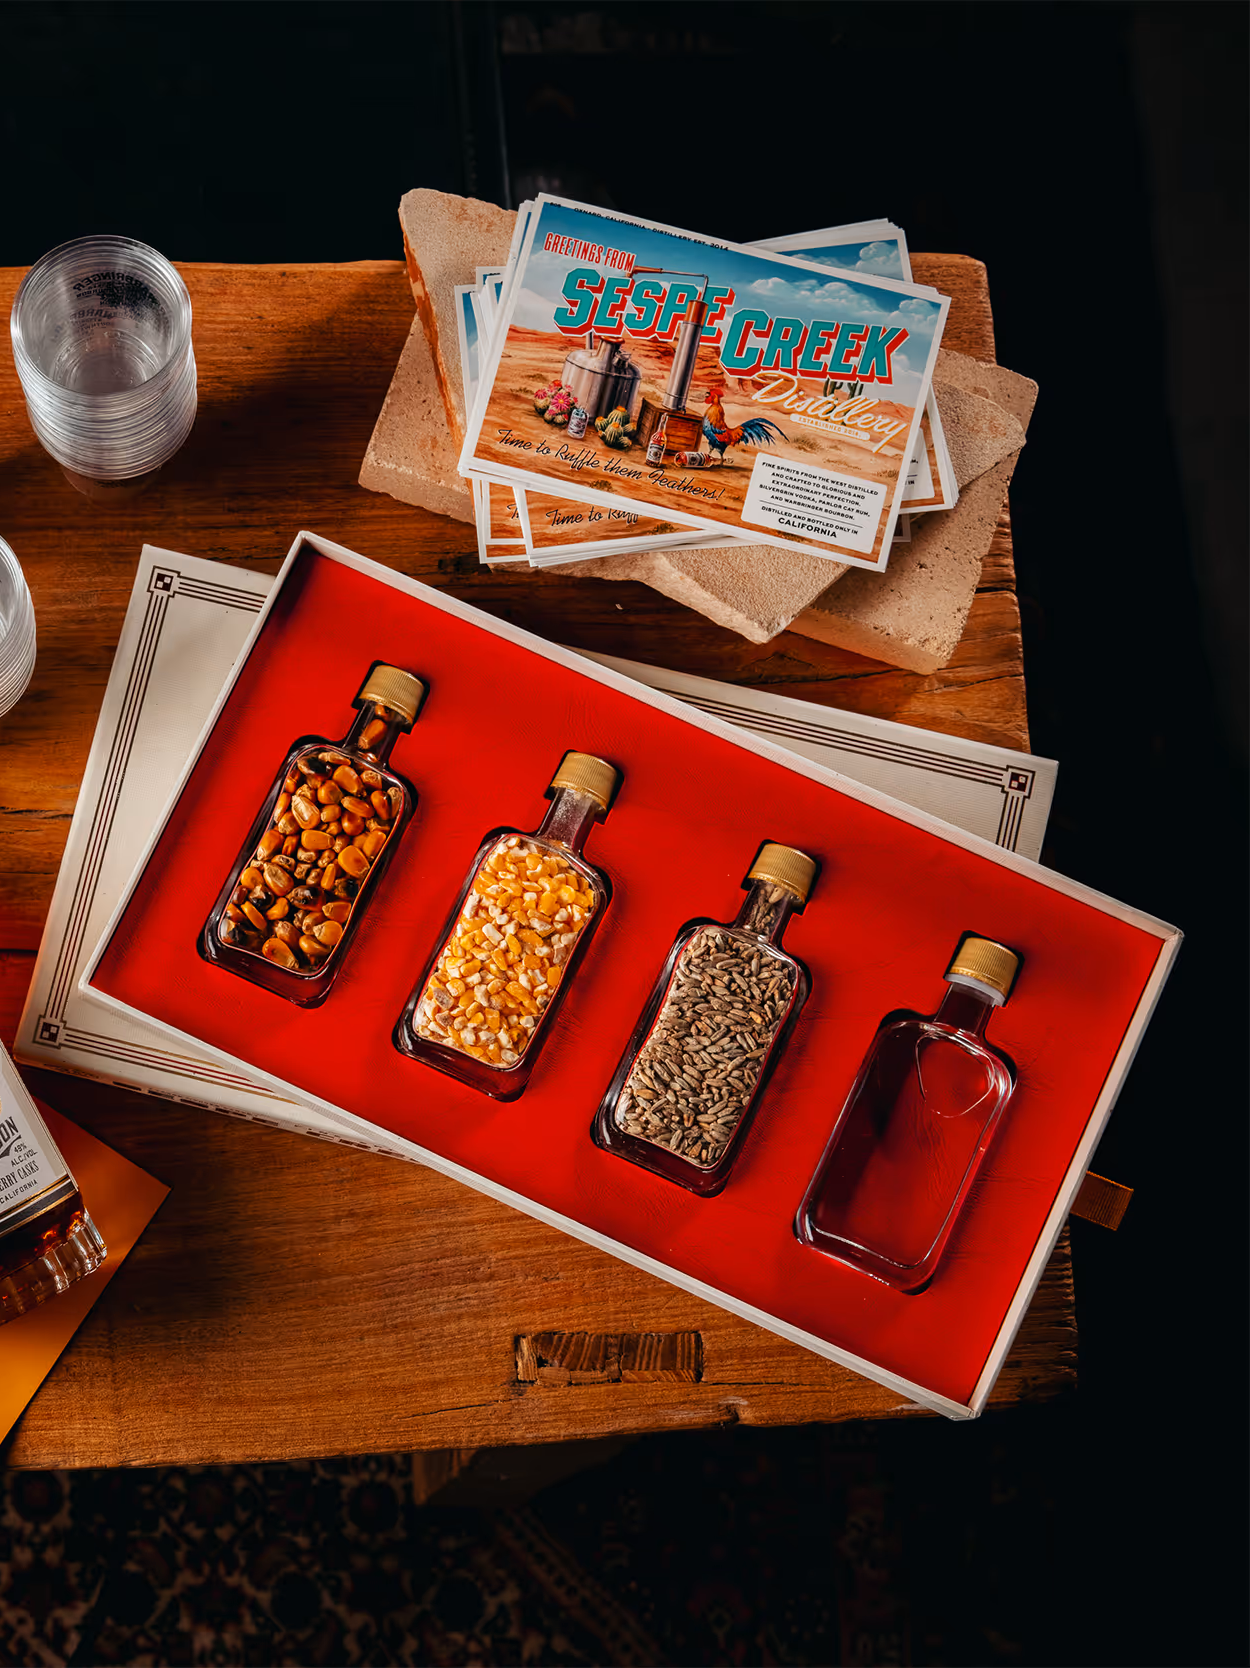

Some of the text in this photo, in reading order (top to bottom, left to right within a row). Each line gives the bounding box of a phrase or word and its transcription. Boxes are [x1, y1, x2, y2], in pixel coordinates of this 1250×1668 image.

[574, 207, 730, 251] OXNARD, CALIFORNIA DISTILLERY EST. 2014
[543, 232, 637, 273] GREETINGS FROM
[553, 266, 737, 346] SESPE
[719, 306, 911, 386] CREEK
[751, 370, 908, 454] Distillery
[798, 416, 843, 434] ESTABLISHED
[498, 428, 726, 501] Time to Ruffle them Feathers!
[762, 462, 776, 470] FINE
[776, 465, 800, 475] SPIRITS
[800, 472, 818, 480] FROM
[830, 479, 848, 488] WEST
[848, 484, 879, 496] DISTILLED
[785, 475, 812, 486] CRAFTED
[822, 484, 852, 497] GLORIOUS
[759, 484, 794, 496] SILVERGRIN
[795, 493, 818, 504] VODKA,
[818, 499, 842, 509] PARLOR
[856, 508, 871, 518] RUM,
[772, 480, 862, 506] EXTRAORDINARY PERFECTION.
[546, 509, 584, 527] Time
[588, 506, 604, 522] to
[762, 506, 792, 518] DISTILLED
[807, 517, 834, 528] BOTTLED
[834, 524, 852, 532] ONLY
[784, 498, 824, 512] WARBRINGER
[824, 508, 856, 520] BOURBON.
[778, 517, 838, 538] CALIFORNIA
[14, 1142, 28, 1154] 49%
[18, 1160, 40, 1183] CASKS
